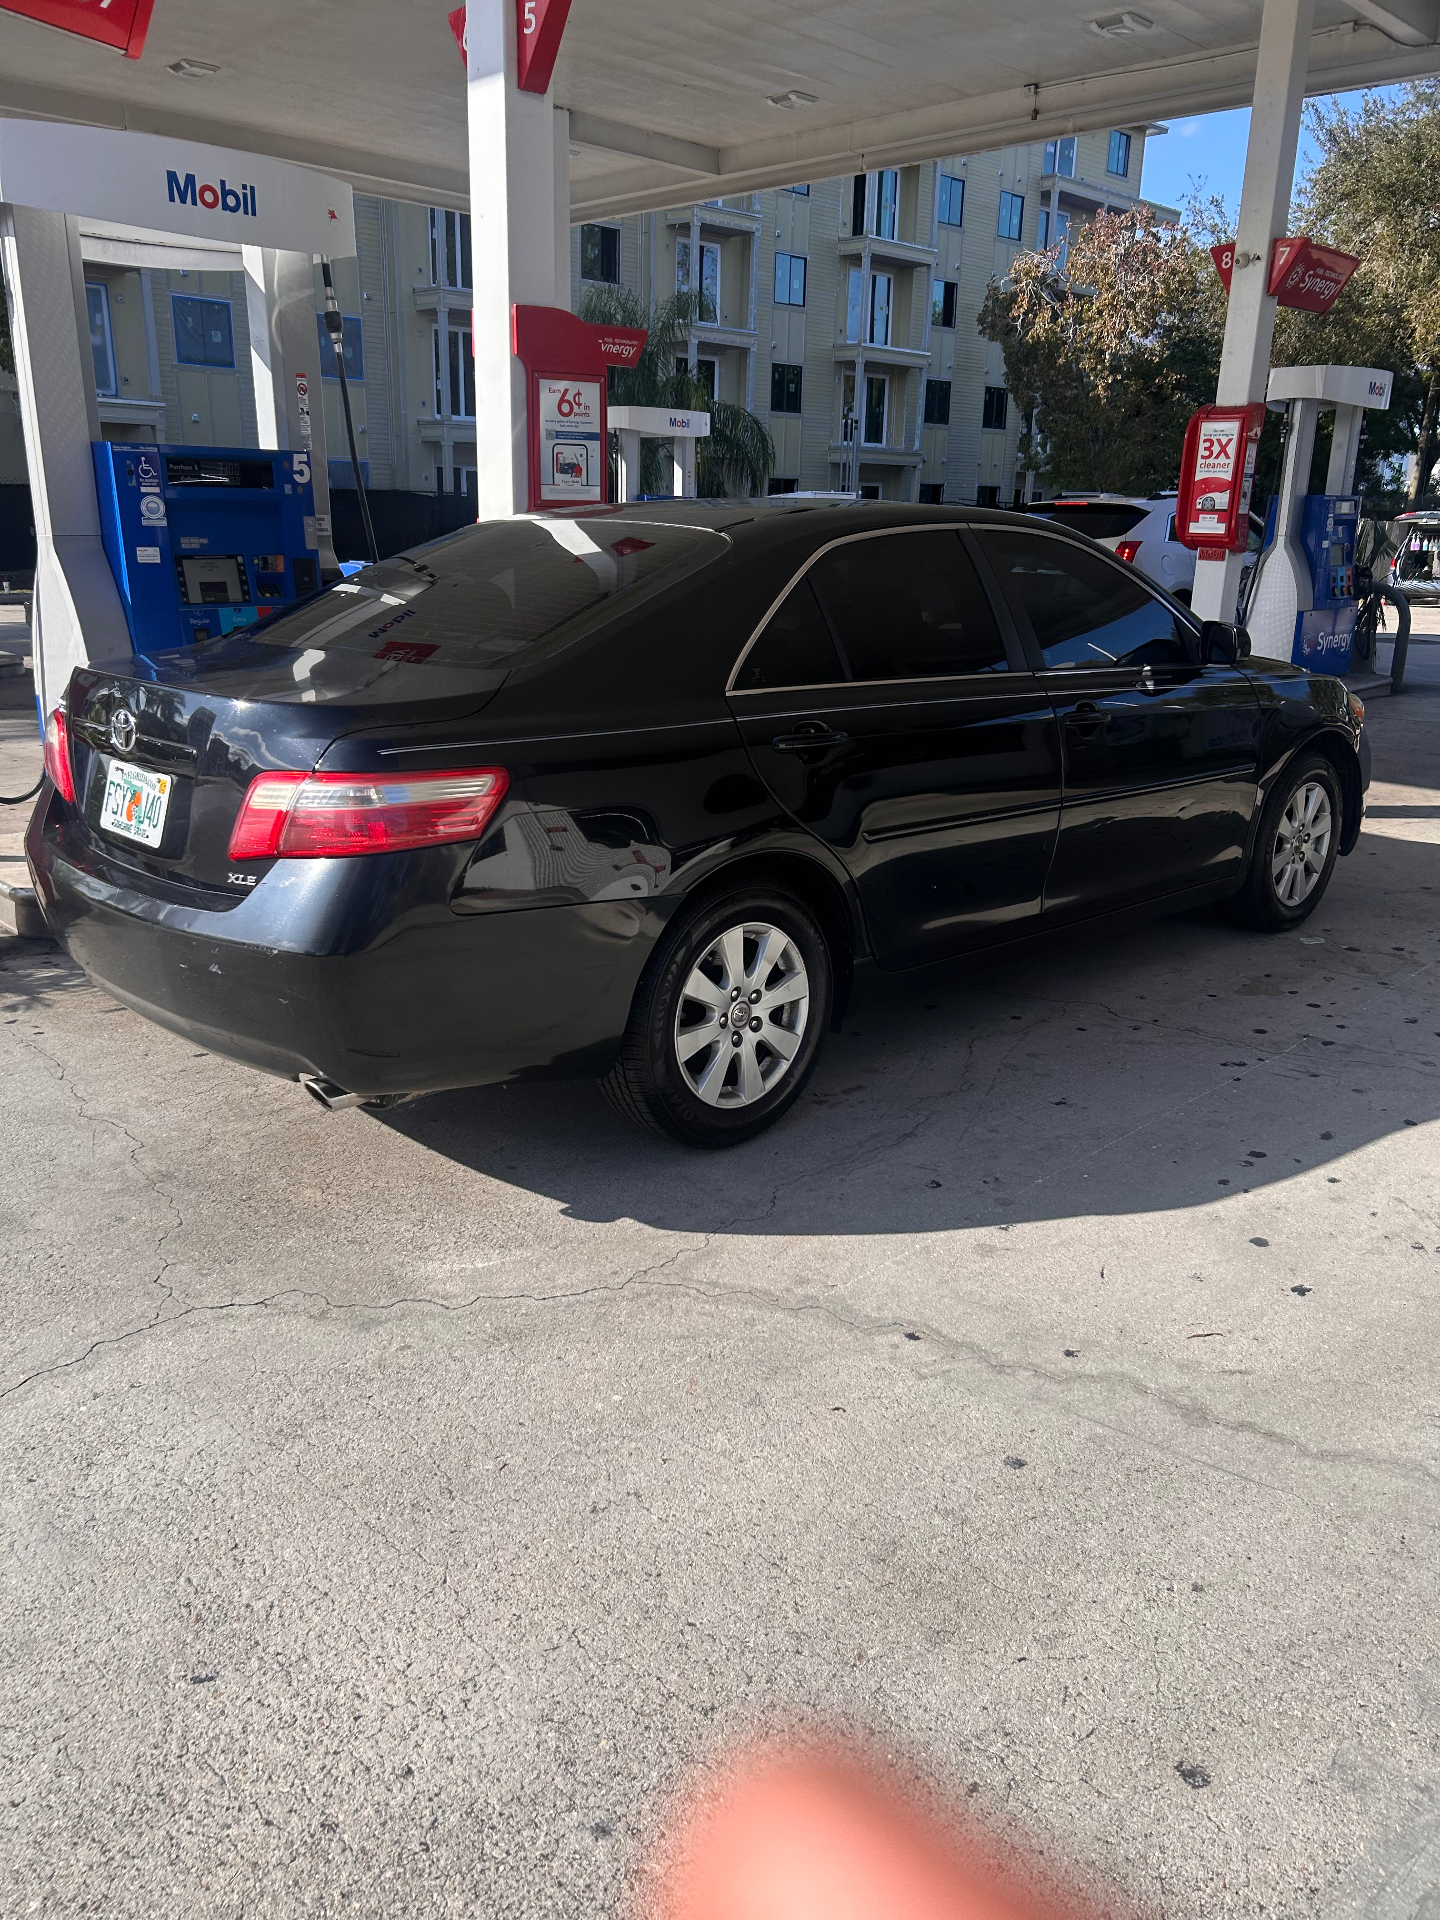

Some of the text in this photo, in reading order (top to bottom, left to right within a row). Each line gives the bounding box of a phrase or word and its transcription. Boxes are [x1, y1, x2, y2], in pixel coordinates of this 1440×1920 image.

[523, 1, 536, 35] 5
[165, 169, 257, 218] Mobil
[1221, 251, 1232, 269] 8
[1278, 246, 1291, 265] 7
[1300, 270, 1341, 300] Synergy
[557, 388, 583, 418] 6¢
[583, 403, 591, 411] in
[573, 411, 591, 419] points
[1201, 438, 1234, 460] 3X
[169, 463, 193, 471] Purchase
[292, 453, 311, 484] 5
[1199, 460, 1231, 469] cleaner
[189, 617, 211, 626] Regular
[1316, 631, 1353, 656] Synergy
[137, 791, 162, 829] J40
[226, 871, 258, 886] XLE
